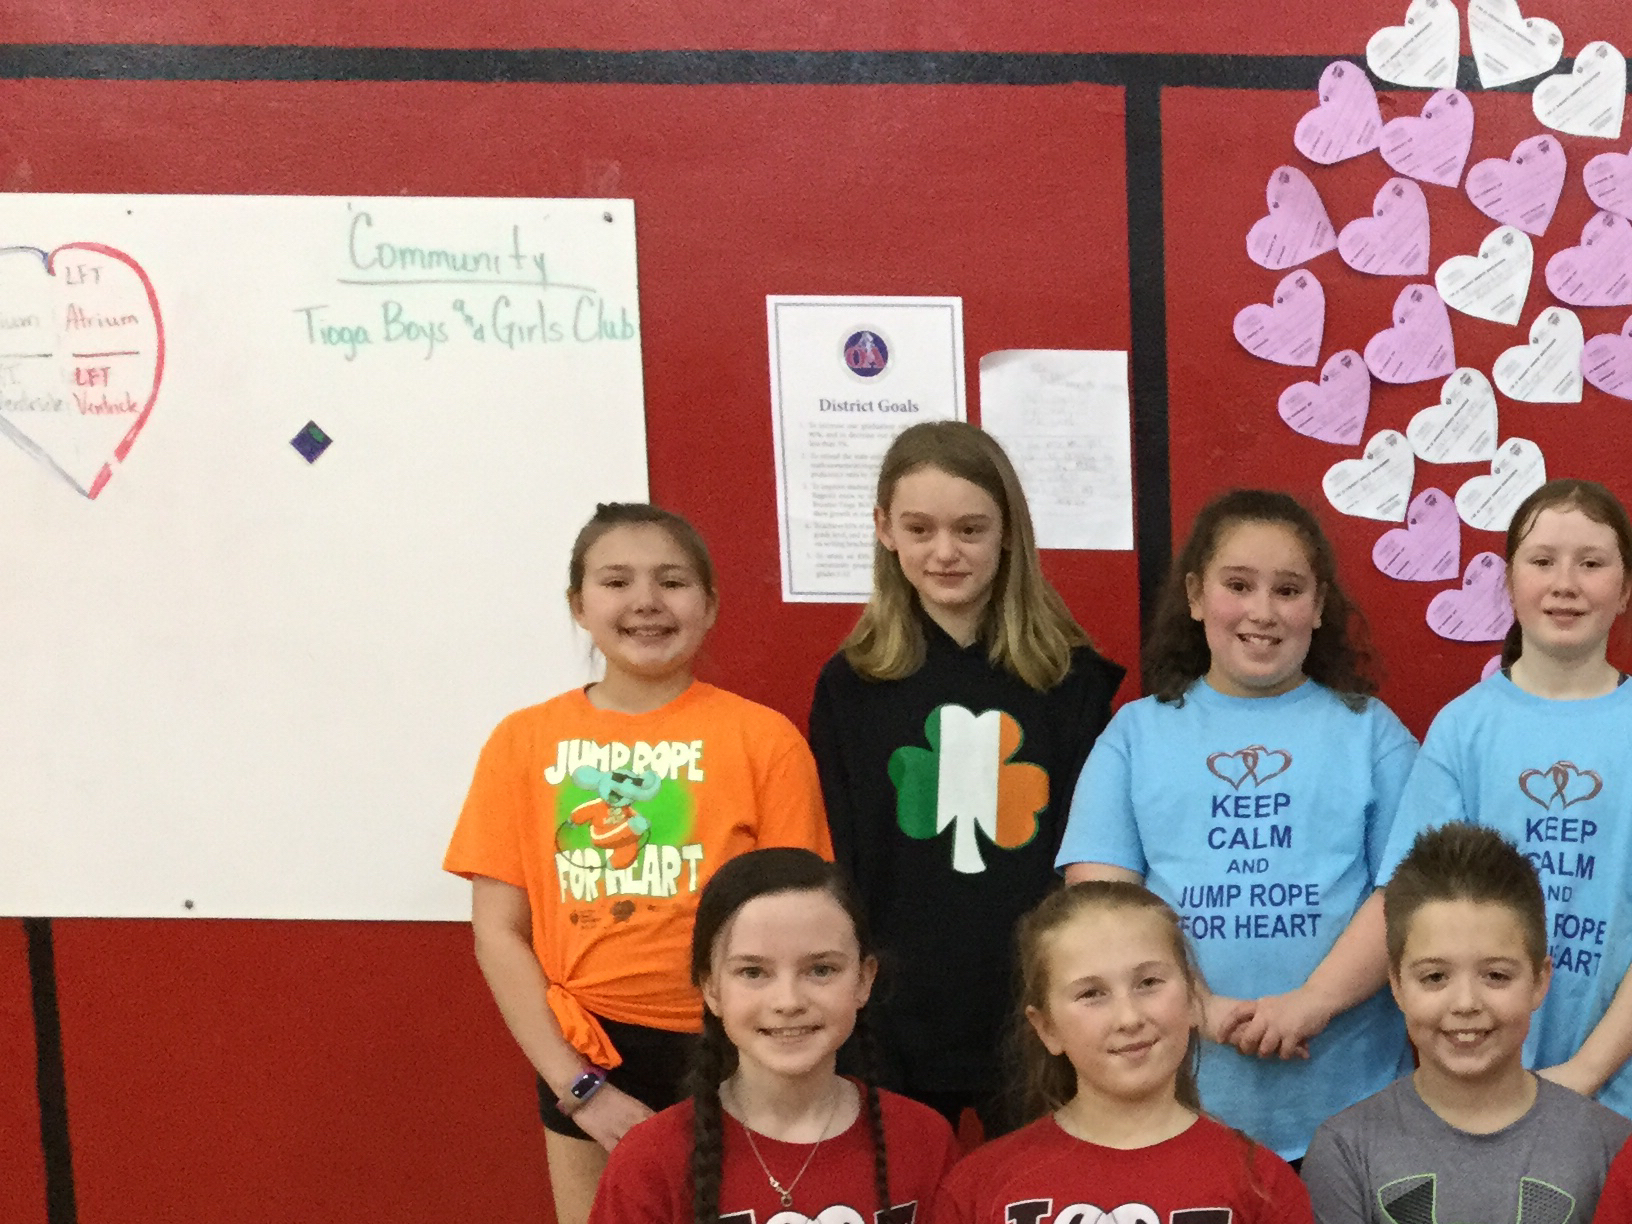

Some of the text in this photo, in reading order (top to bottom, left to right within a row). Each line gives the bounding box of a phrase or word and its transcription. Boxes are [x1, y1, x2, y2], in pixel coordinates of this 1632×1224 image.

[348, 210, 548, 291] Community
[65, 302, 140, 332] Atrium
[291, 303, 377, 362] Tioga
[381, 300, 450, 361] Boys
[491, 294, 564, 350] Girls
[572, 294, 635, 344] Club
[73, 366, 112, 387] LFT
[818, 398, 920, 413] District Goals
[1211, 792, 1292, 819] KEEP
[1207, 824, 1293, 850] CALM
[1526, 816, 1598, 845] KEEP
[555, 848, 602, 903] FOR
[1226, 857, 1270, 875] AND
[1177, 883, 1321, 910] JUMP ROPE
[1547, 884, 1573, 903] ND
[1235, 913, 1322, 940] HEART
[1549, 943, 1603, 977] ART
